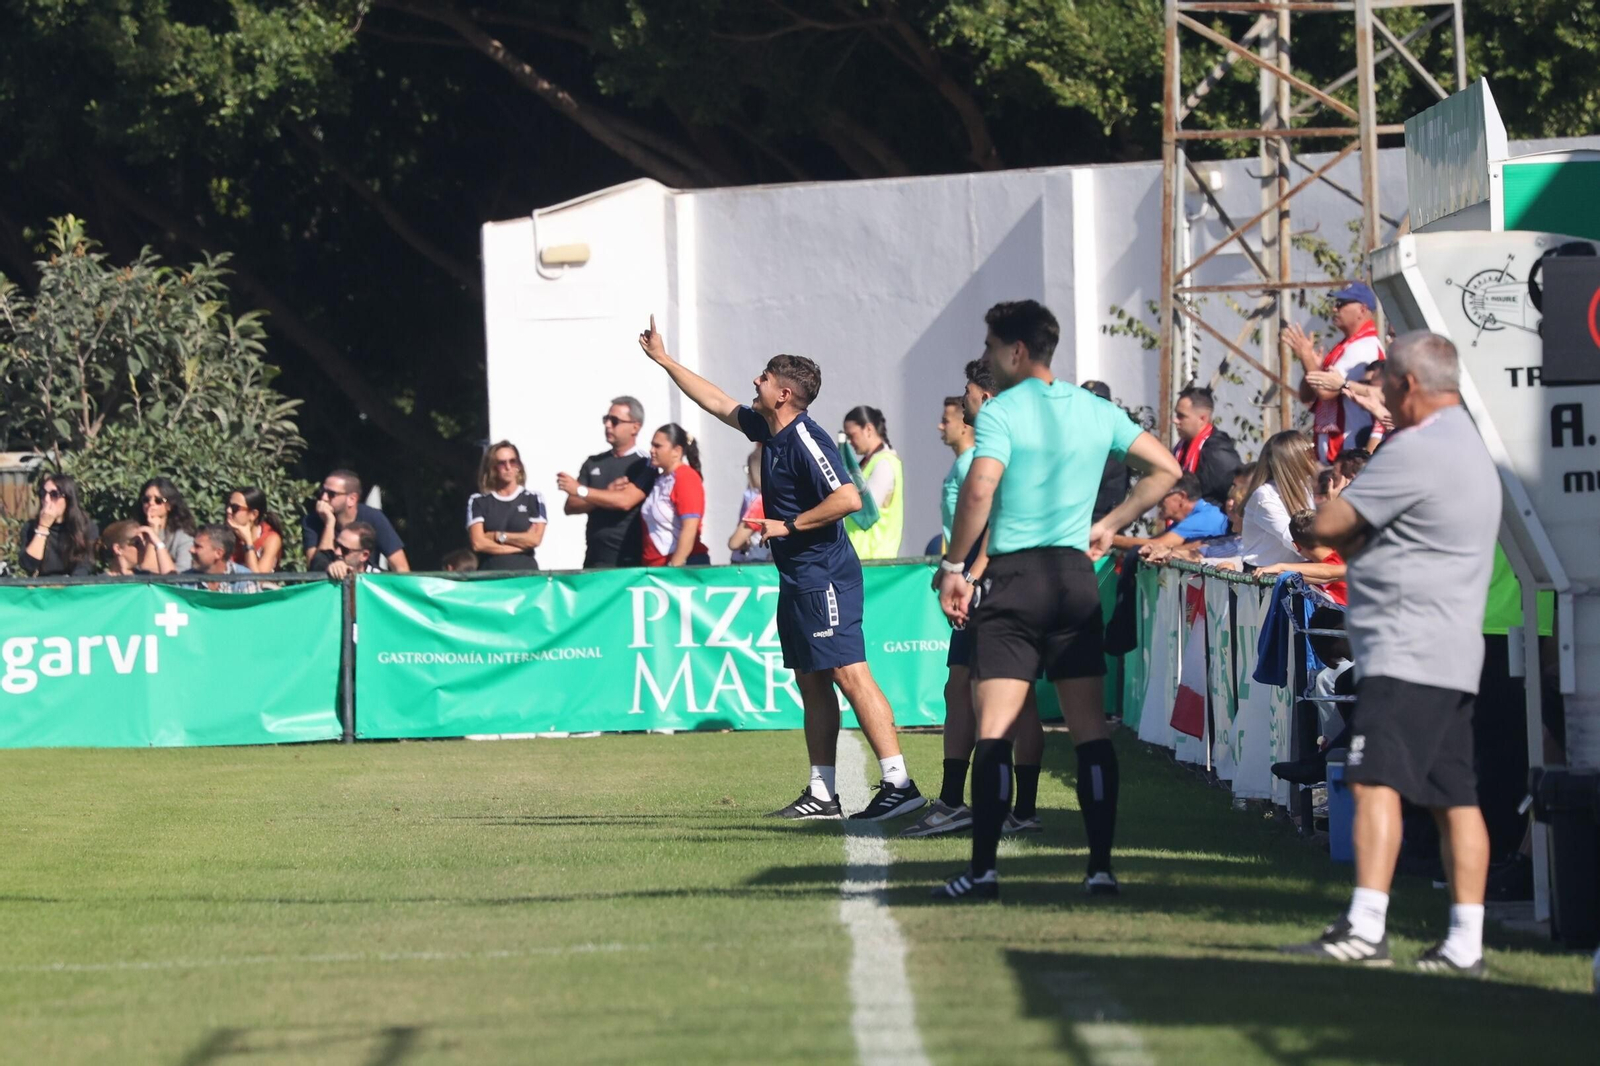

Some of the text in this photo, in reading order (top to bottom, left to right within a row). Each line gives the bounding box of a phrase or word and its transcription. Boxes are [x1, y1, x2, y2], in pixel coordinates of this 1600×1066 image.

[377, 647, 603, 665] GASTRONOMÍA INTERNACIONAL
[627, 651, 850, 714] MAR
